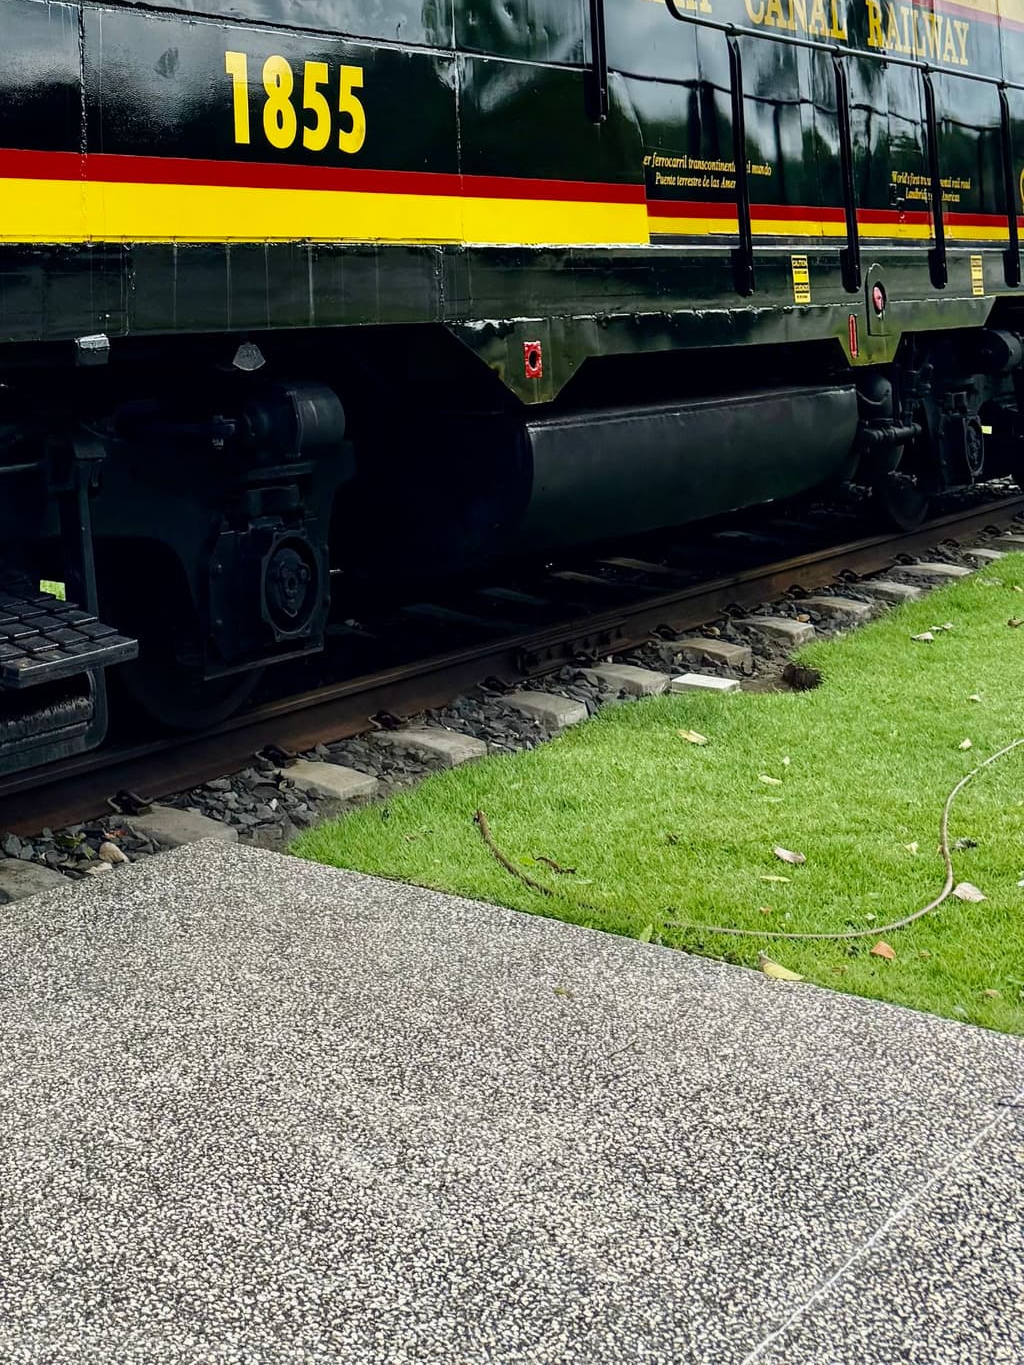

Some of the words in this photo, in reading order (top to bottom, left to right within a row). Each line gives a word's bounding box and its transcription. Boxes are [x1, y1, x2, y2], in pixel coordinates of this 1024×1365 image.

[225, 50, 366, 154] 1855
[652, 152, 687, 169] ferrocarril
[688, 157, 736, 173] transcontinent
[655, 172, 676, 186] Puente
[676, 175, 701, 187] terrestre
[702, 175, 710, 187] de
[710, 175, 720, 188] las
[720, 176, 736, 189] Amer
